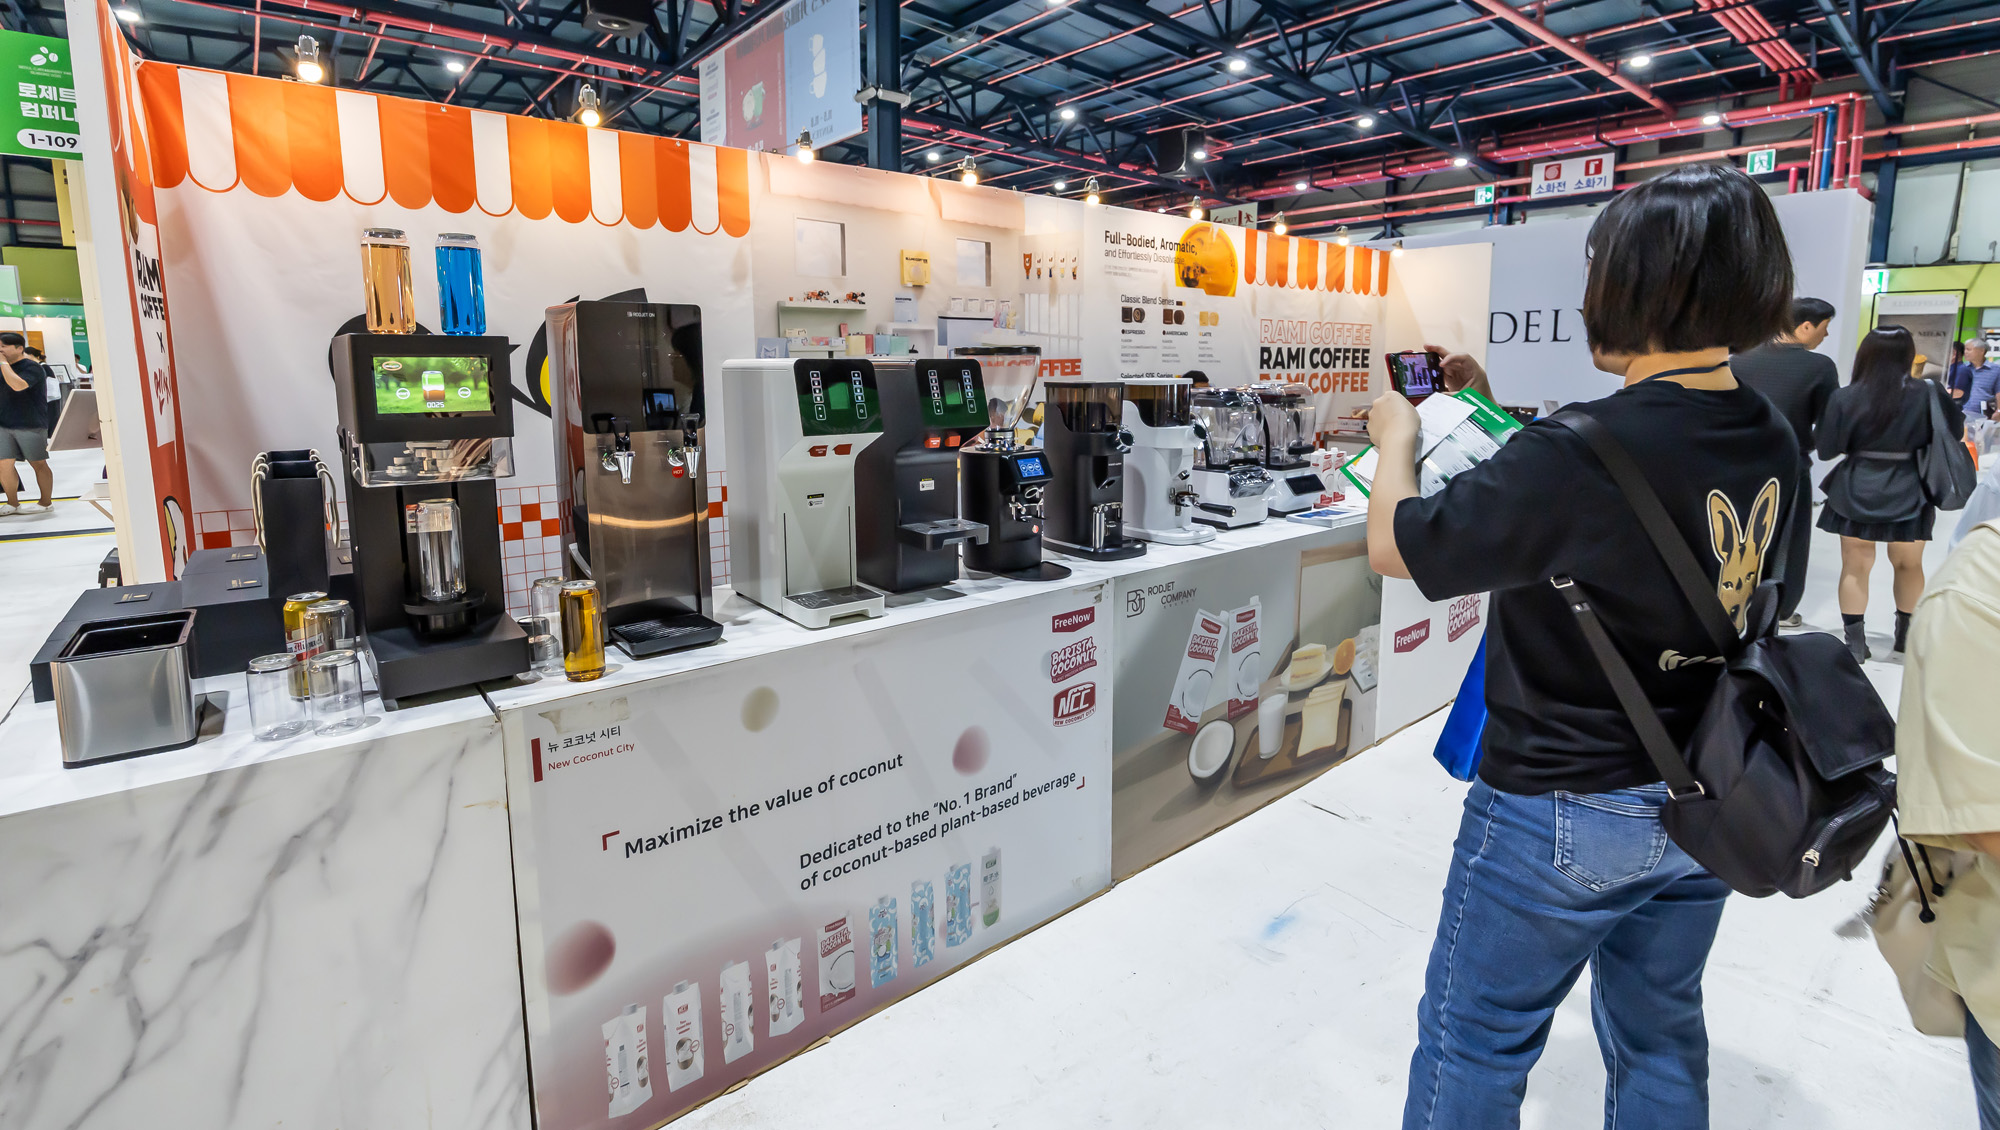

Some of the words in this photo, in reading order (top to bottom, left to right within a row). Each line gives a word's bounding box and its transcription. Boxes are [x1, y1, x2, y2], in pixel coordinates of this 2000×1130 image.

[18, 82, 76, 103] 로제트
[20, 101, 79, 122] 컴퍼니
[28, 133, 78, 148] 1-109
[1535, 181, 1566, 195] 소화전
[1574, 176, 1607, 190] 소화기
[1104, 230, 1158, 250] Full-Bodied,
[1160, 238, 1198, 256] Aromatic,
[1104, 248, 1116, 258] and
[1118, 249, 1152, 263] Effortlessly
[1120, 294, 1140, 304] Classic
[1142, 296, 1157, 304] Blend
[1158, 297, 1174, 306] Series
[1260, 318, 1307, 344] RAMI
[1309, 322, 1372, 346] COFFEE
[1260, 346, 1306, 369] RAMI
[1309, 348, 1370, 369] COFFEE
[1308, 372, 1369, 394] COFFEE
[1160, 588, 1197, 604] COMPANY
[1054, 613, 1091, 629] FreeNow
[1448, 602, 1480, 634] COCONUT
[1192, 634, 1218, 648] BARISTA
[1232, 622, 1257, 640] BARISTA
[1232, 630, 1258, 648] COCONUT
[1396, 627, 1427, 648] FreeNow
[1052, 638, 1094, 665] BARISTA
[1188, 643, 1218, 656] COCONUT
[1052, 647, 1096, 677] COCONUT
[1058, 683, 1094, 717] NCC
[1065, 713, 1084, 724] COCONUT
[548, 742, 559, 753] 뉴
[562, 731, 596, 749] 코코넛
[600, 725, 620, 739] 시티
[548, 760, 571, 771] New
[573, 748, 614, 764] Coconut
[616, 743, 635, 754] City
[625, 814, 723, 858] Maximize
[728, 802, 760, 824] the
[764, 784, 813, 812] value
[817, 775, 836, 794] of
[839, 754, 904, 786] coconut
[800, 825, 882, 869] Dedicated
[886, 819, 902, 836] to
[906, 807, 930, 828] the
[963, 792, 970, 805] 1
[800, 870, 819, 891] of
[822, 824, 938, 882] coconut-based
[941, 791, 1020, 838] plant-based
[1022, 771, 1076, 802] beverage
